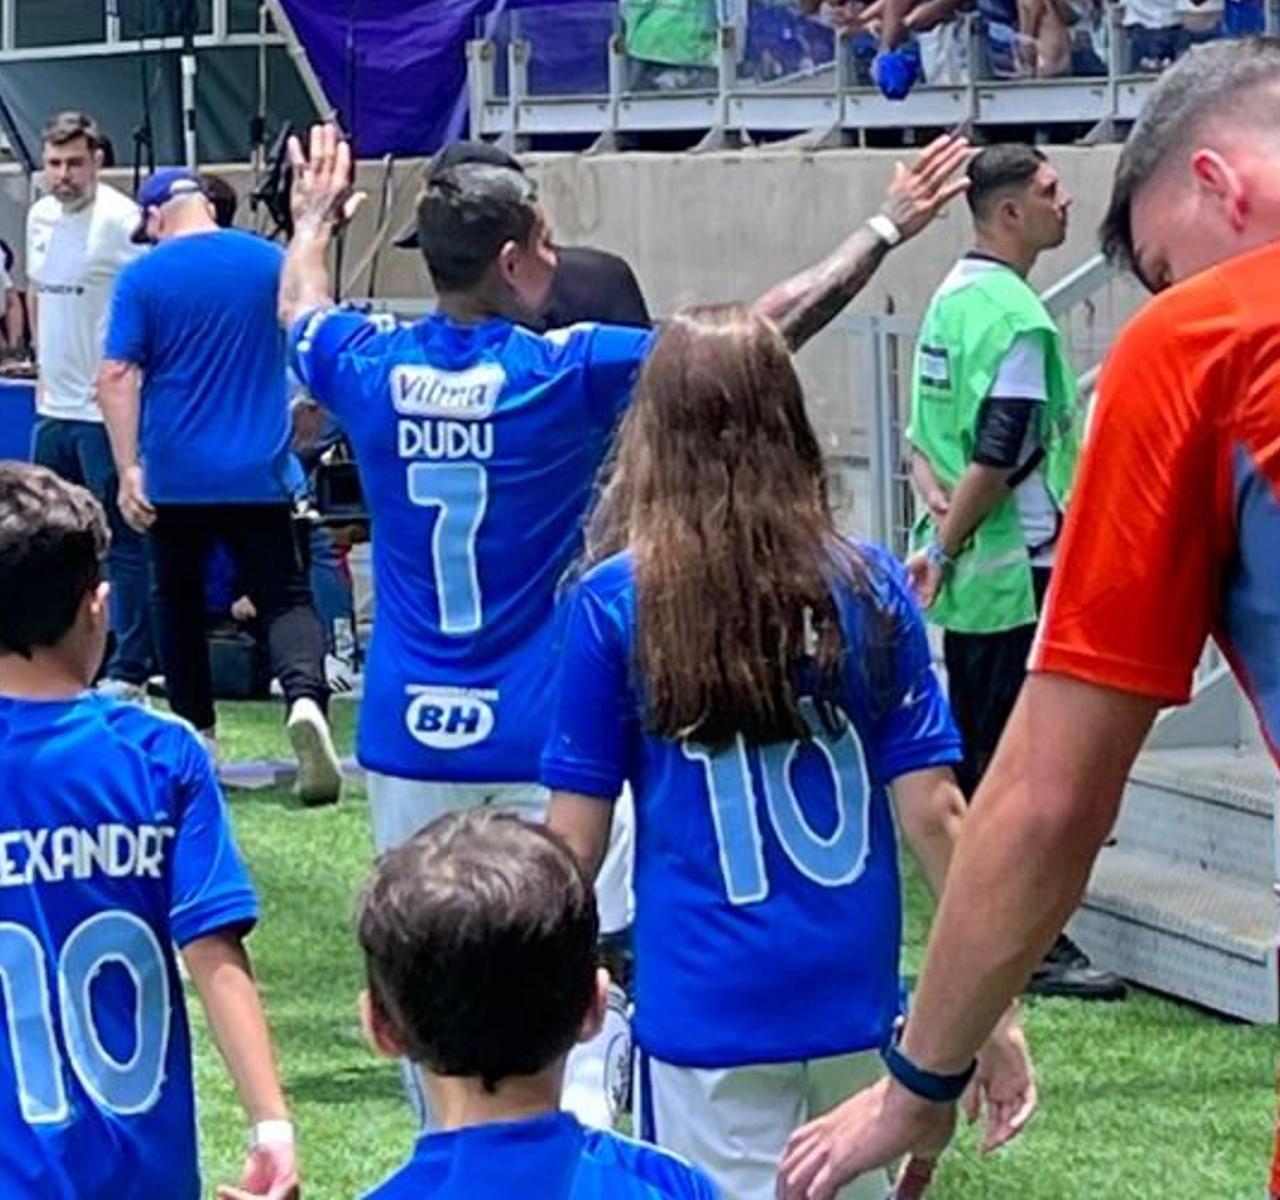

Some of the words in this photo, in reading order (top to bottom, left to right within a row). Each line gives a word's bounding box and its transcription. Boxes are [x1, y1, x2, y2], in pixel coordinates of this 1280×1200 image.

[400, 373, 488, 409] Vilma
[397, 419, 495, 460] DUDU
[407, 462, 488, 635] 7
[415, 704, 480, 734] BH
[681, 697, 871, 906] 10
